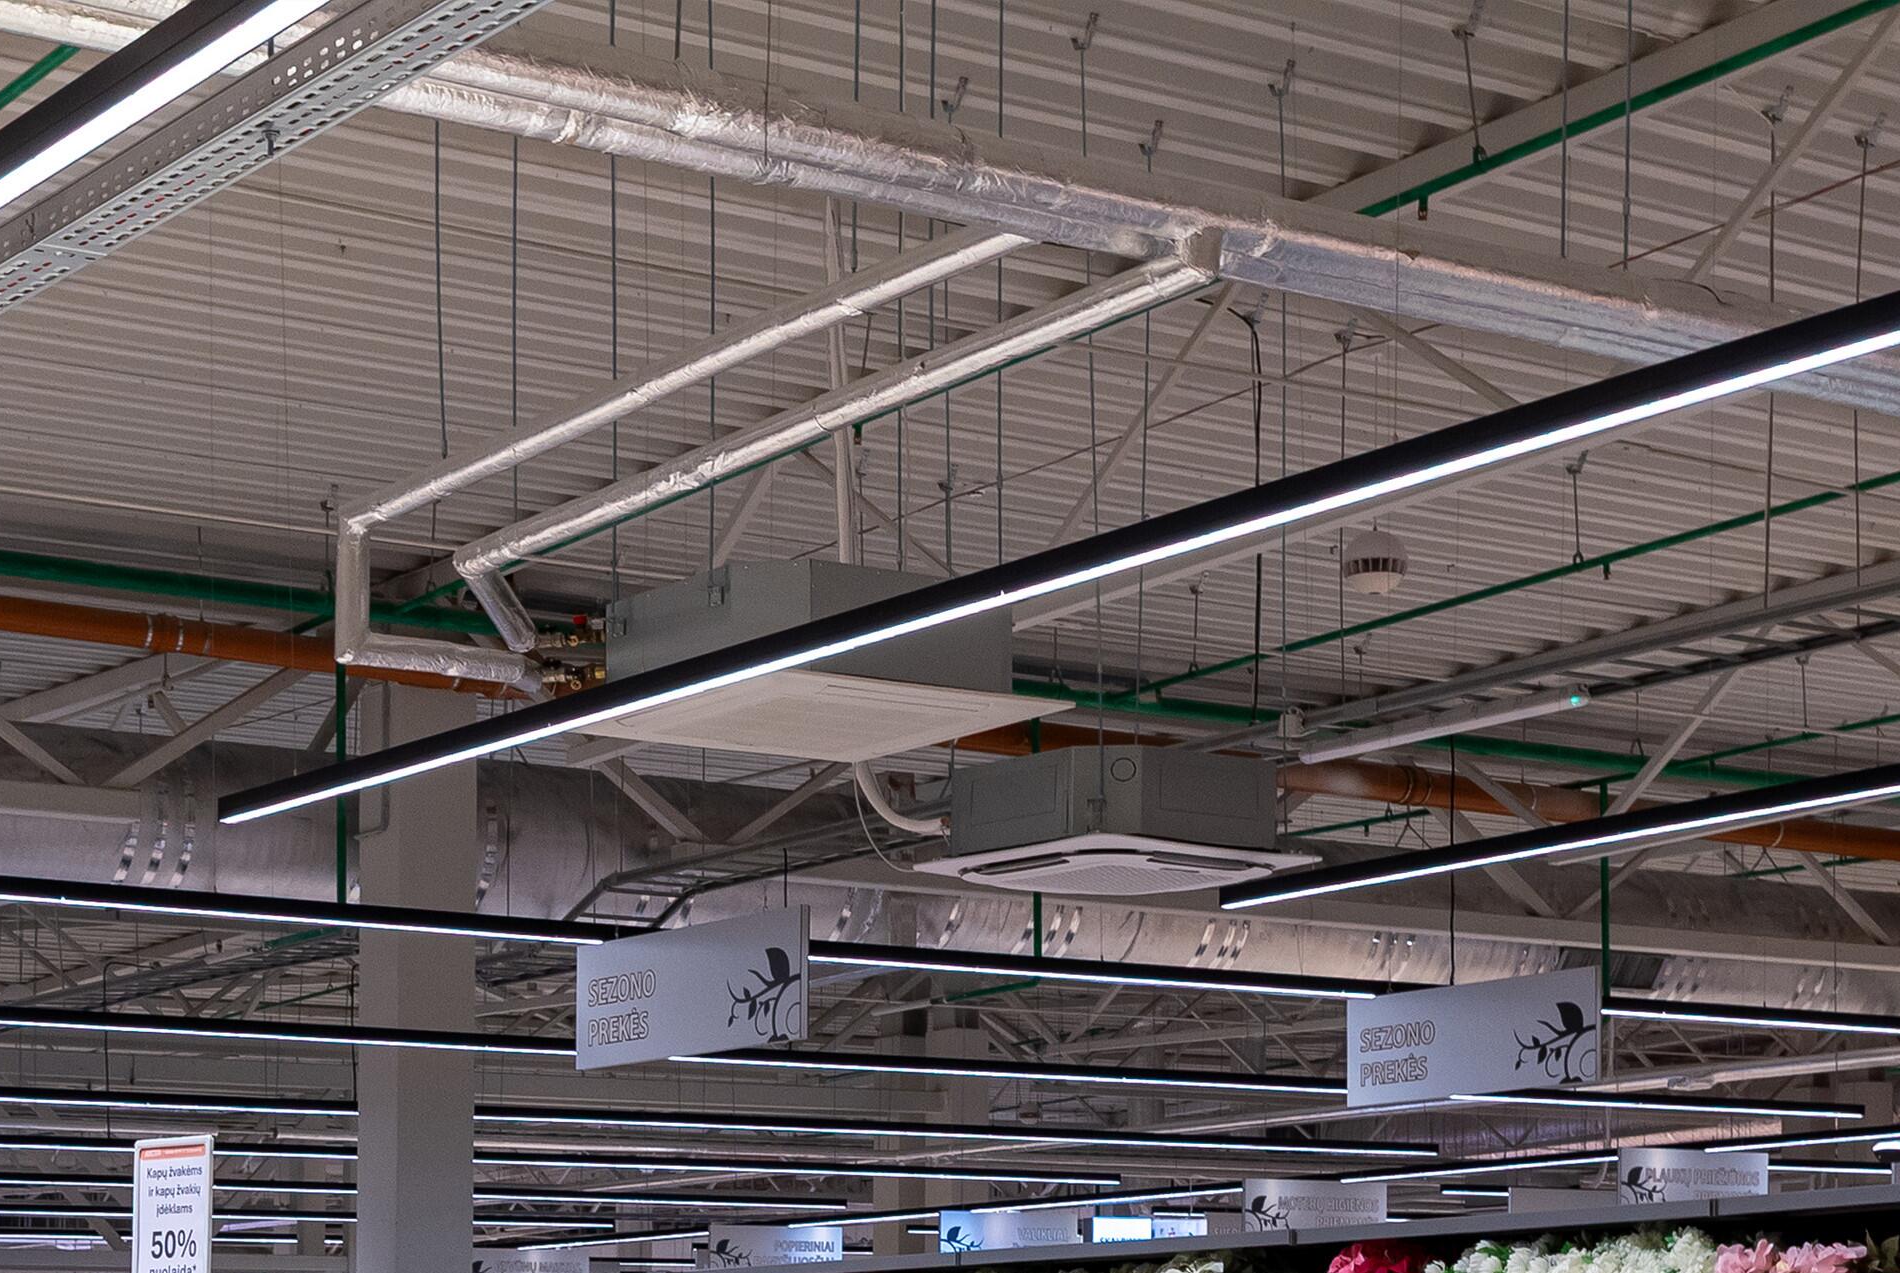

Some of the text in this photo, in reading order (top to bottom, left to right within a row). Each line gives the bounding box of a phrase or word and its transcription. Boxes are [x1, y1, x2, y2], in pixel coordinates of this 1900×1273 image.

[587, 969, 657, 1008] SEZONO
[587, 1009, 650, 1047] PREKĖS
[1360, 1020, 1436, 1053] SEZONO
[1360, 1053, 1428, 1087] PREKĖS
[147, 1165, 203, 1181] Kapų žvakėms
[148, 1186, 155, 1197] ir
[155, 1186, 176, 1200] kapų
[151, 1230, 197, 1260] 50%
[774, 1240, 835, 1253] POPIERINIAI
